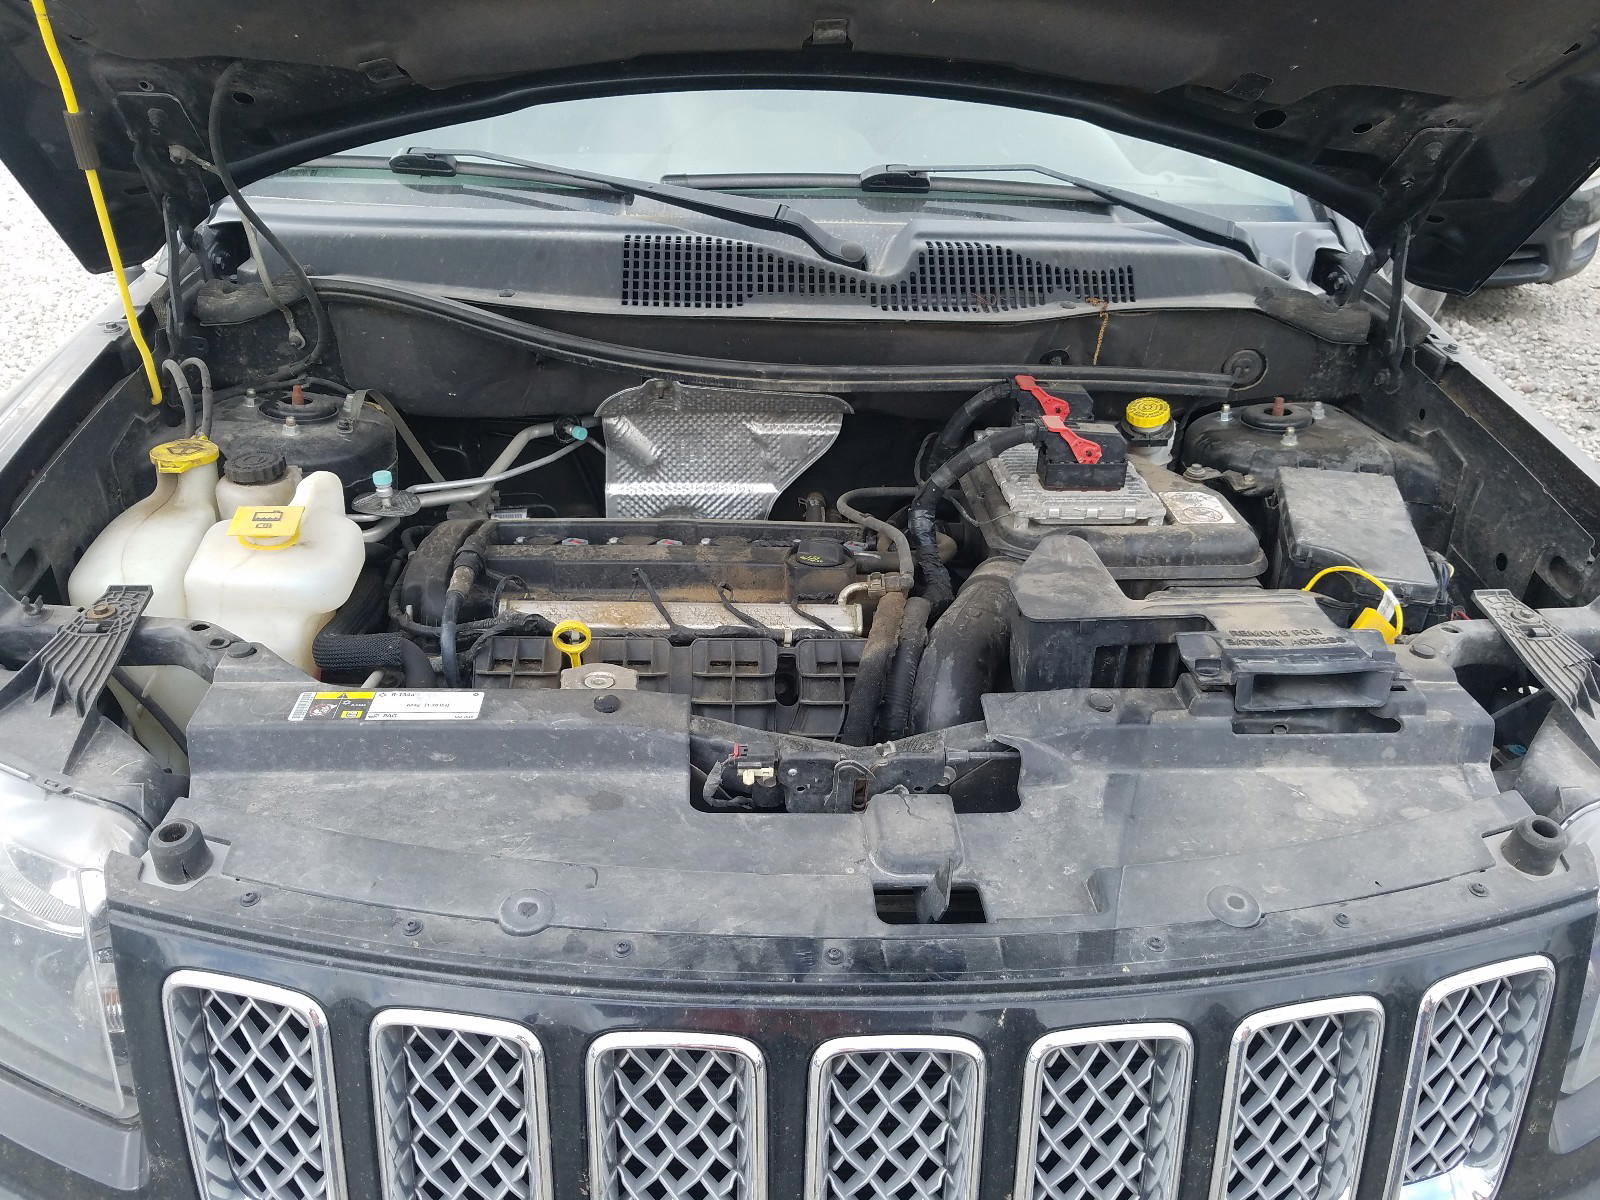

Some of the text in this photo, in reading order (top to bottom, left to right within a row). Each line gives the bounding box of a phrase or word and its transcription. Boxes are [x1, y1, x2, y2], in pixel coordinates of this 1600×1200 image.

[1228, 628, 1322, 638] REMOVE FOR
[1225, 636, 1347, 647] BATTERY ACCESS
